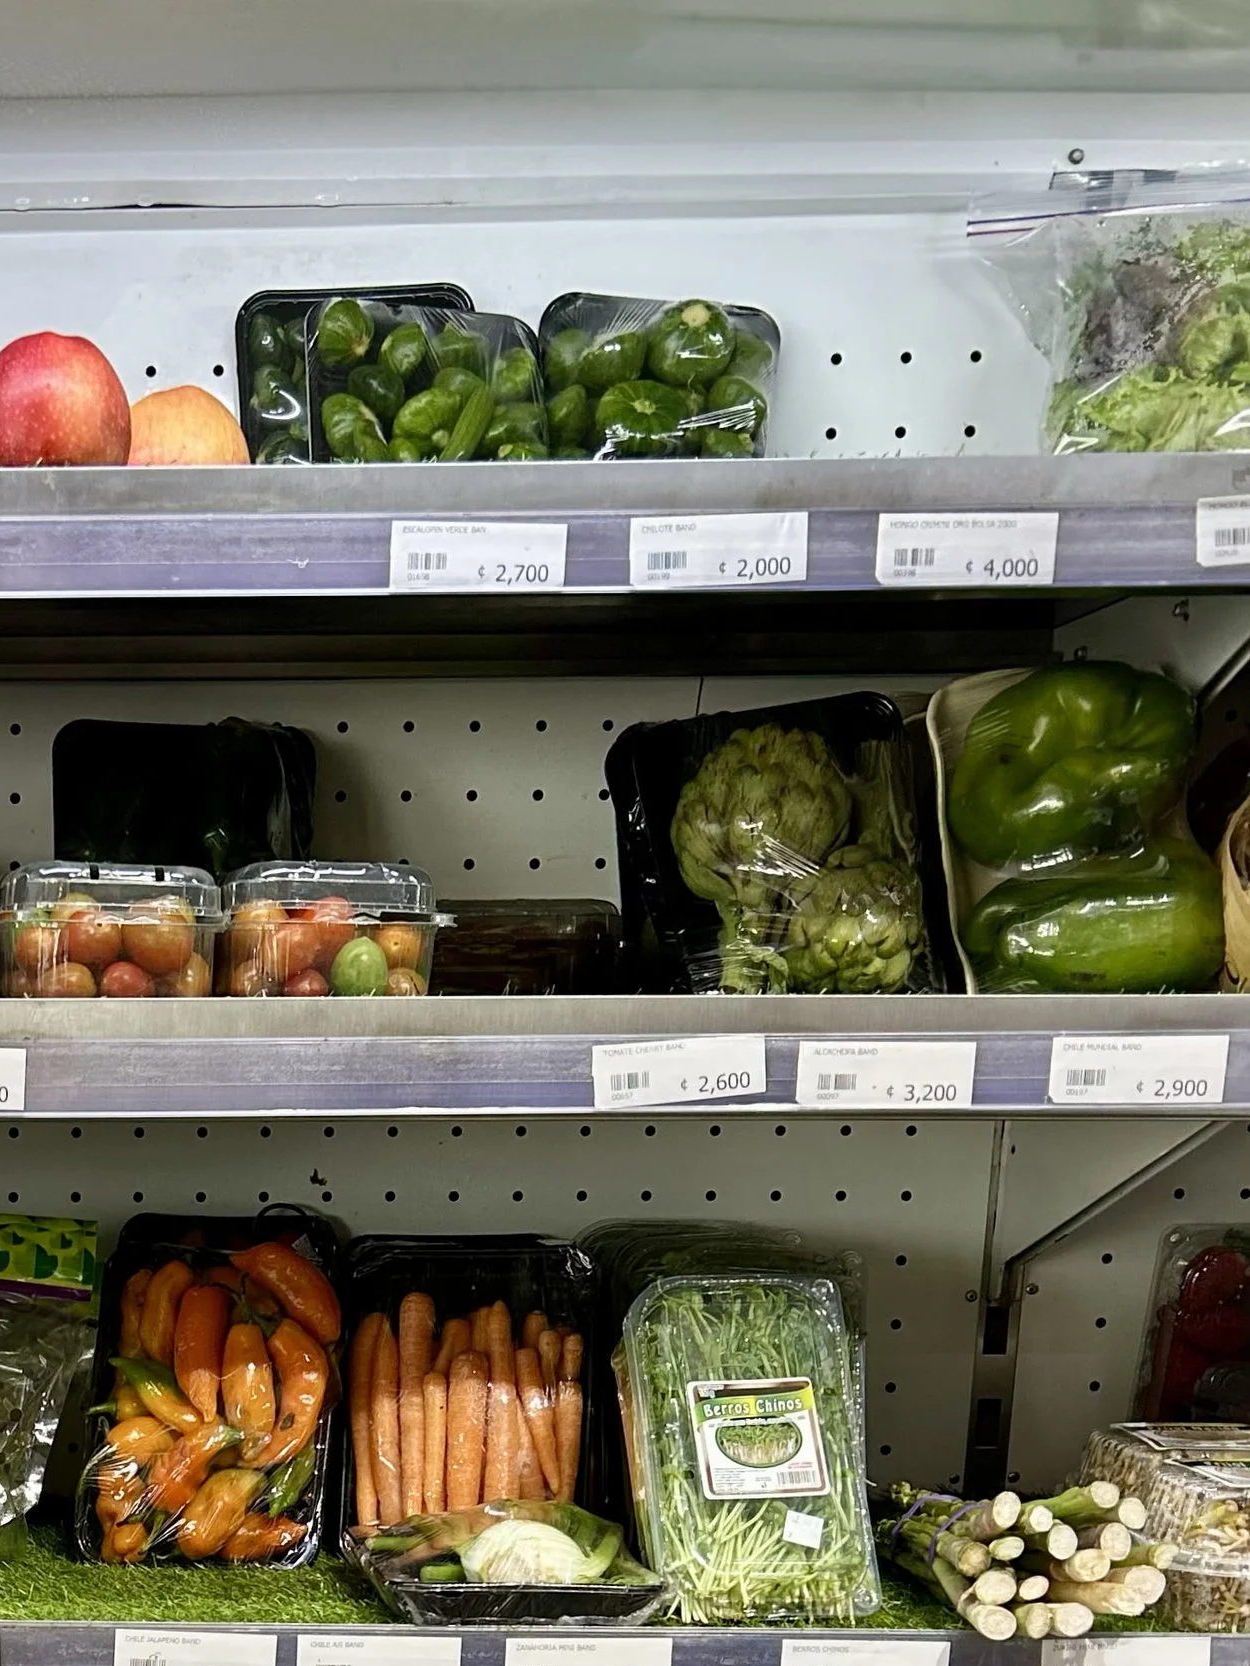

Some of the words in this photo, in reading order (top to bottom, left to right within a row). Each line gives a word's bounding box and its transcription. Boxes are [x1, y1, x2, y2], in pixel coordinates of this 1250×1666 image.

[496, 564, 548, 585] 2,700
[737, 557, 790, 580] 2,000
[984, 559, 1038, 580] 4,000
[603, 1048, 634, 1057] TOMATE
[699, 1072, 752, 1095] 2,600
[1154, 1080, 1207, 1099] 2,900
[904, 1085, 956, 1104] 3,200
[703, 1403, 750, 1418] Berros
[756, 1398, 803, 1413] Chinos
